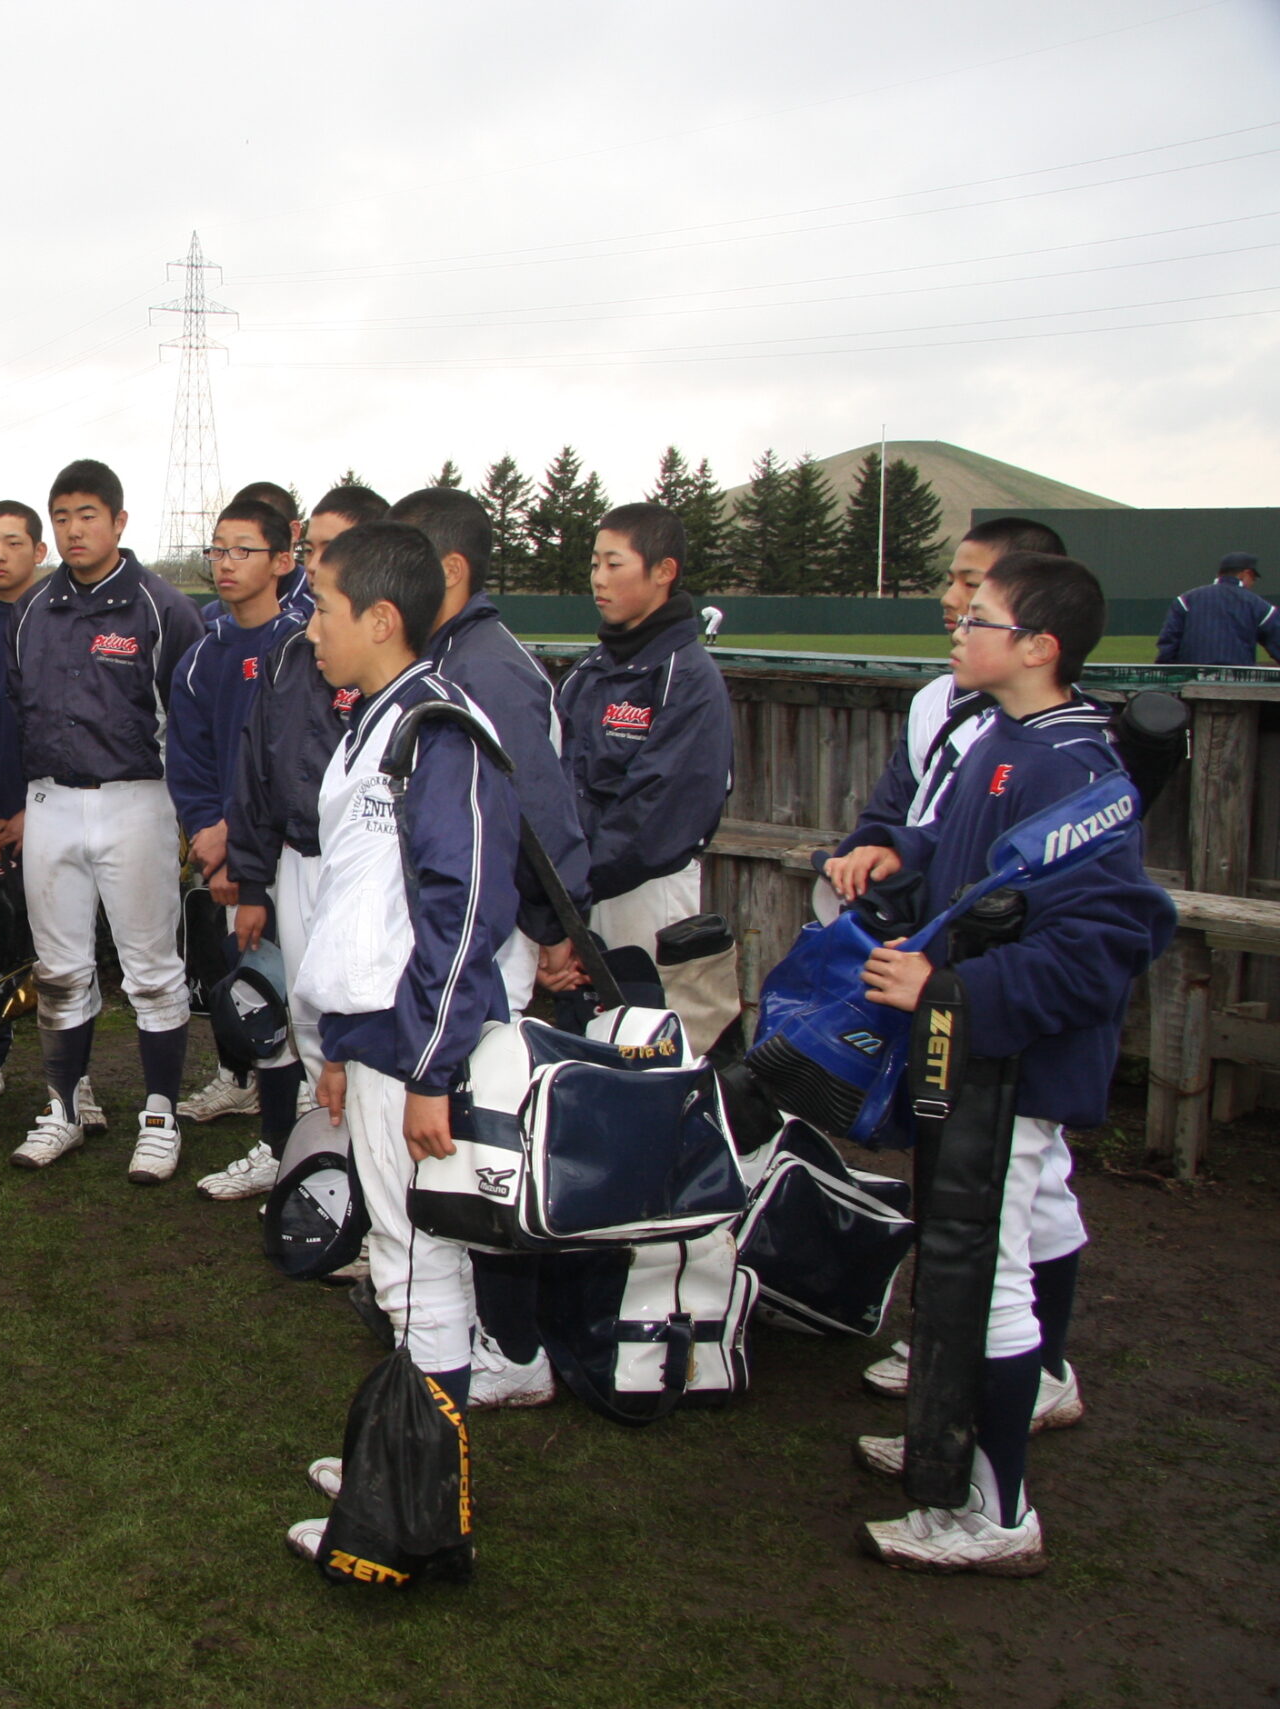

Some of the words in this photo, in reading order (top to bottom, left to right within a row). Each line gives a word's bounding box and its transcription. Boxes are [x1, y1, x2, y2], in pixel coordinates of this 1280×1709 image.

[242, 656, 258, 681] E
[989, 763, 1014, 797] E
[925, 1007, 953, 1091] ZETT
[329, 1549, 411, 1587] ZETT
